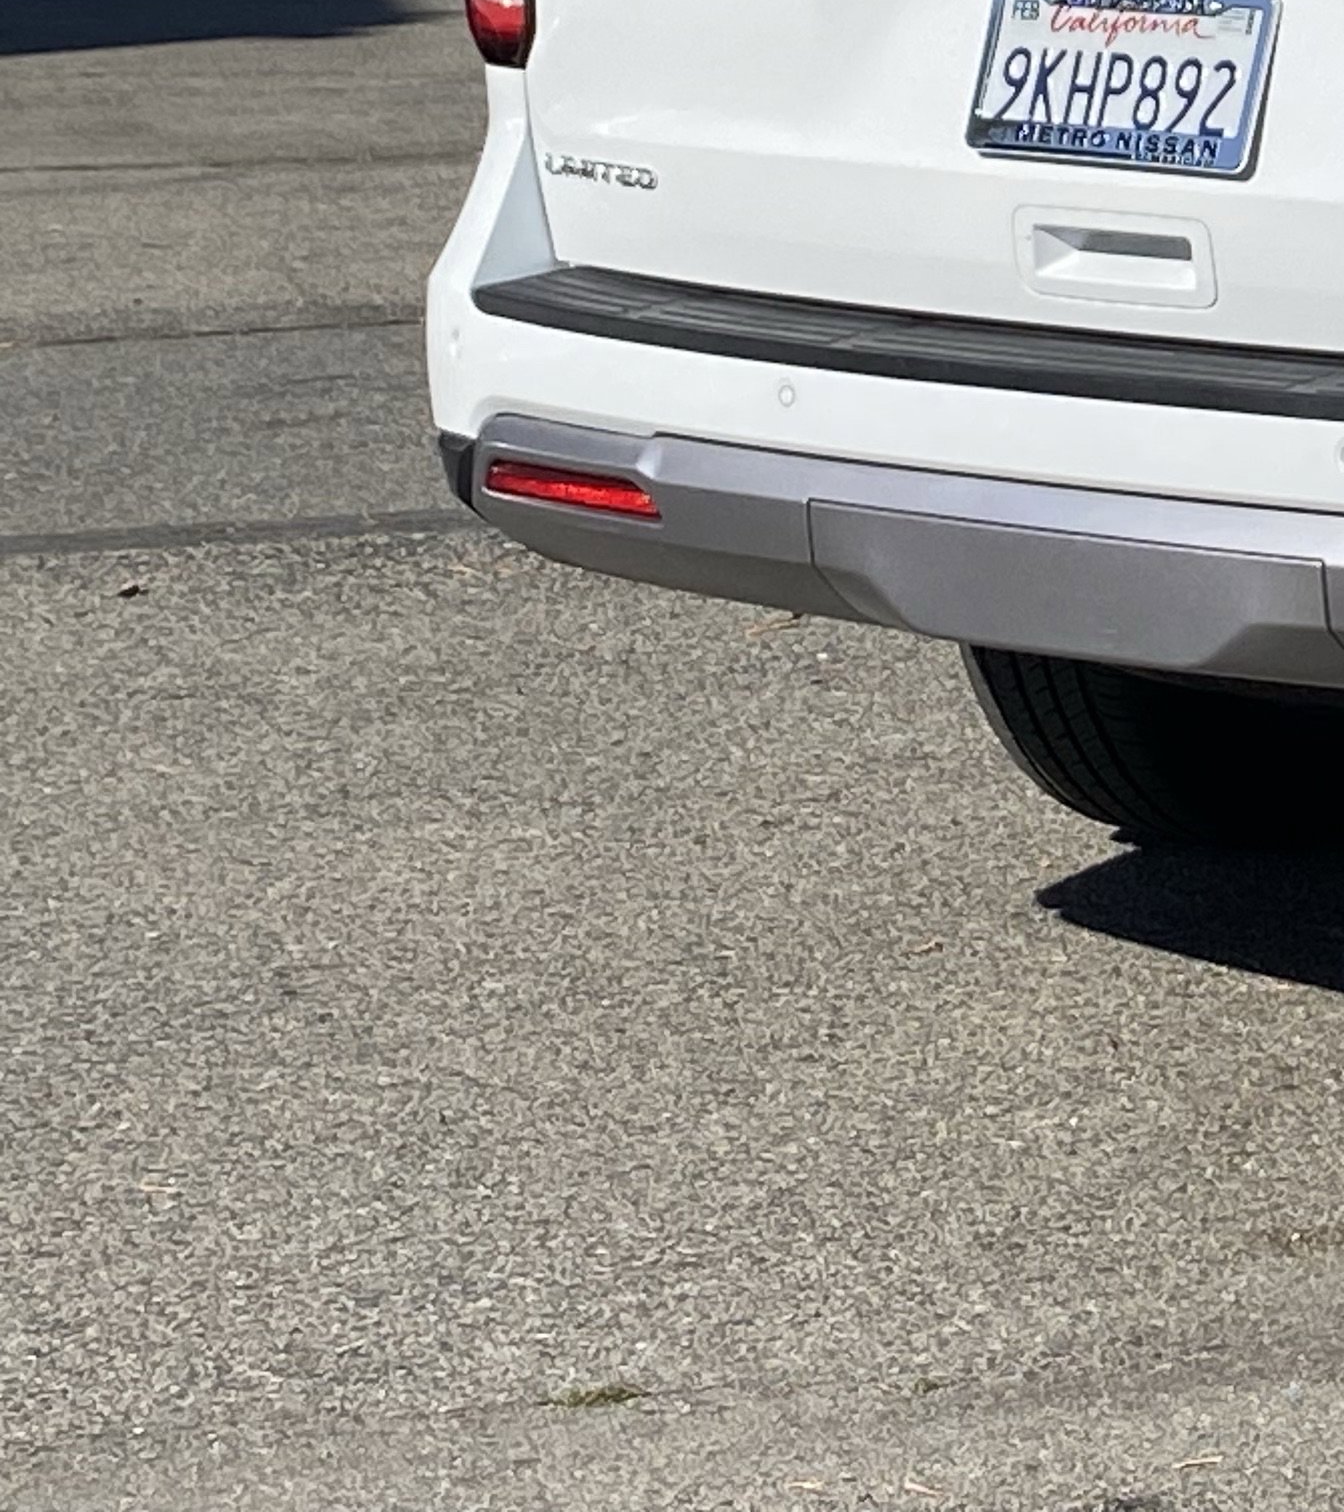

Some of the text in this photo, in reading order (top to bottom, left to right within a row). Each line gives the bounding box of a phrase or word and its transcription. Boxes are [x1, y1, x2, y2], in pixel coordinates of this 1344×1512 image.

[1050, 3, 1216, 48] California
[993, 46, 1238, 138] 9KHP892
[1014, 122, 1218, 159] METRO NISSAN
